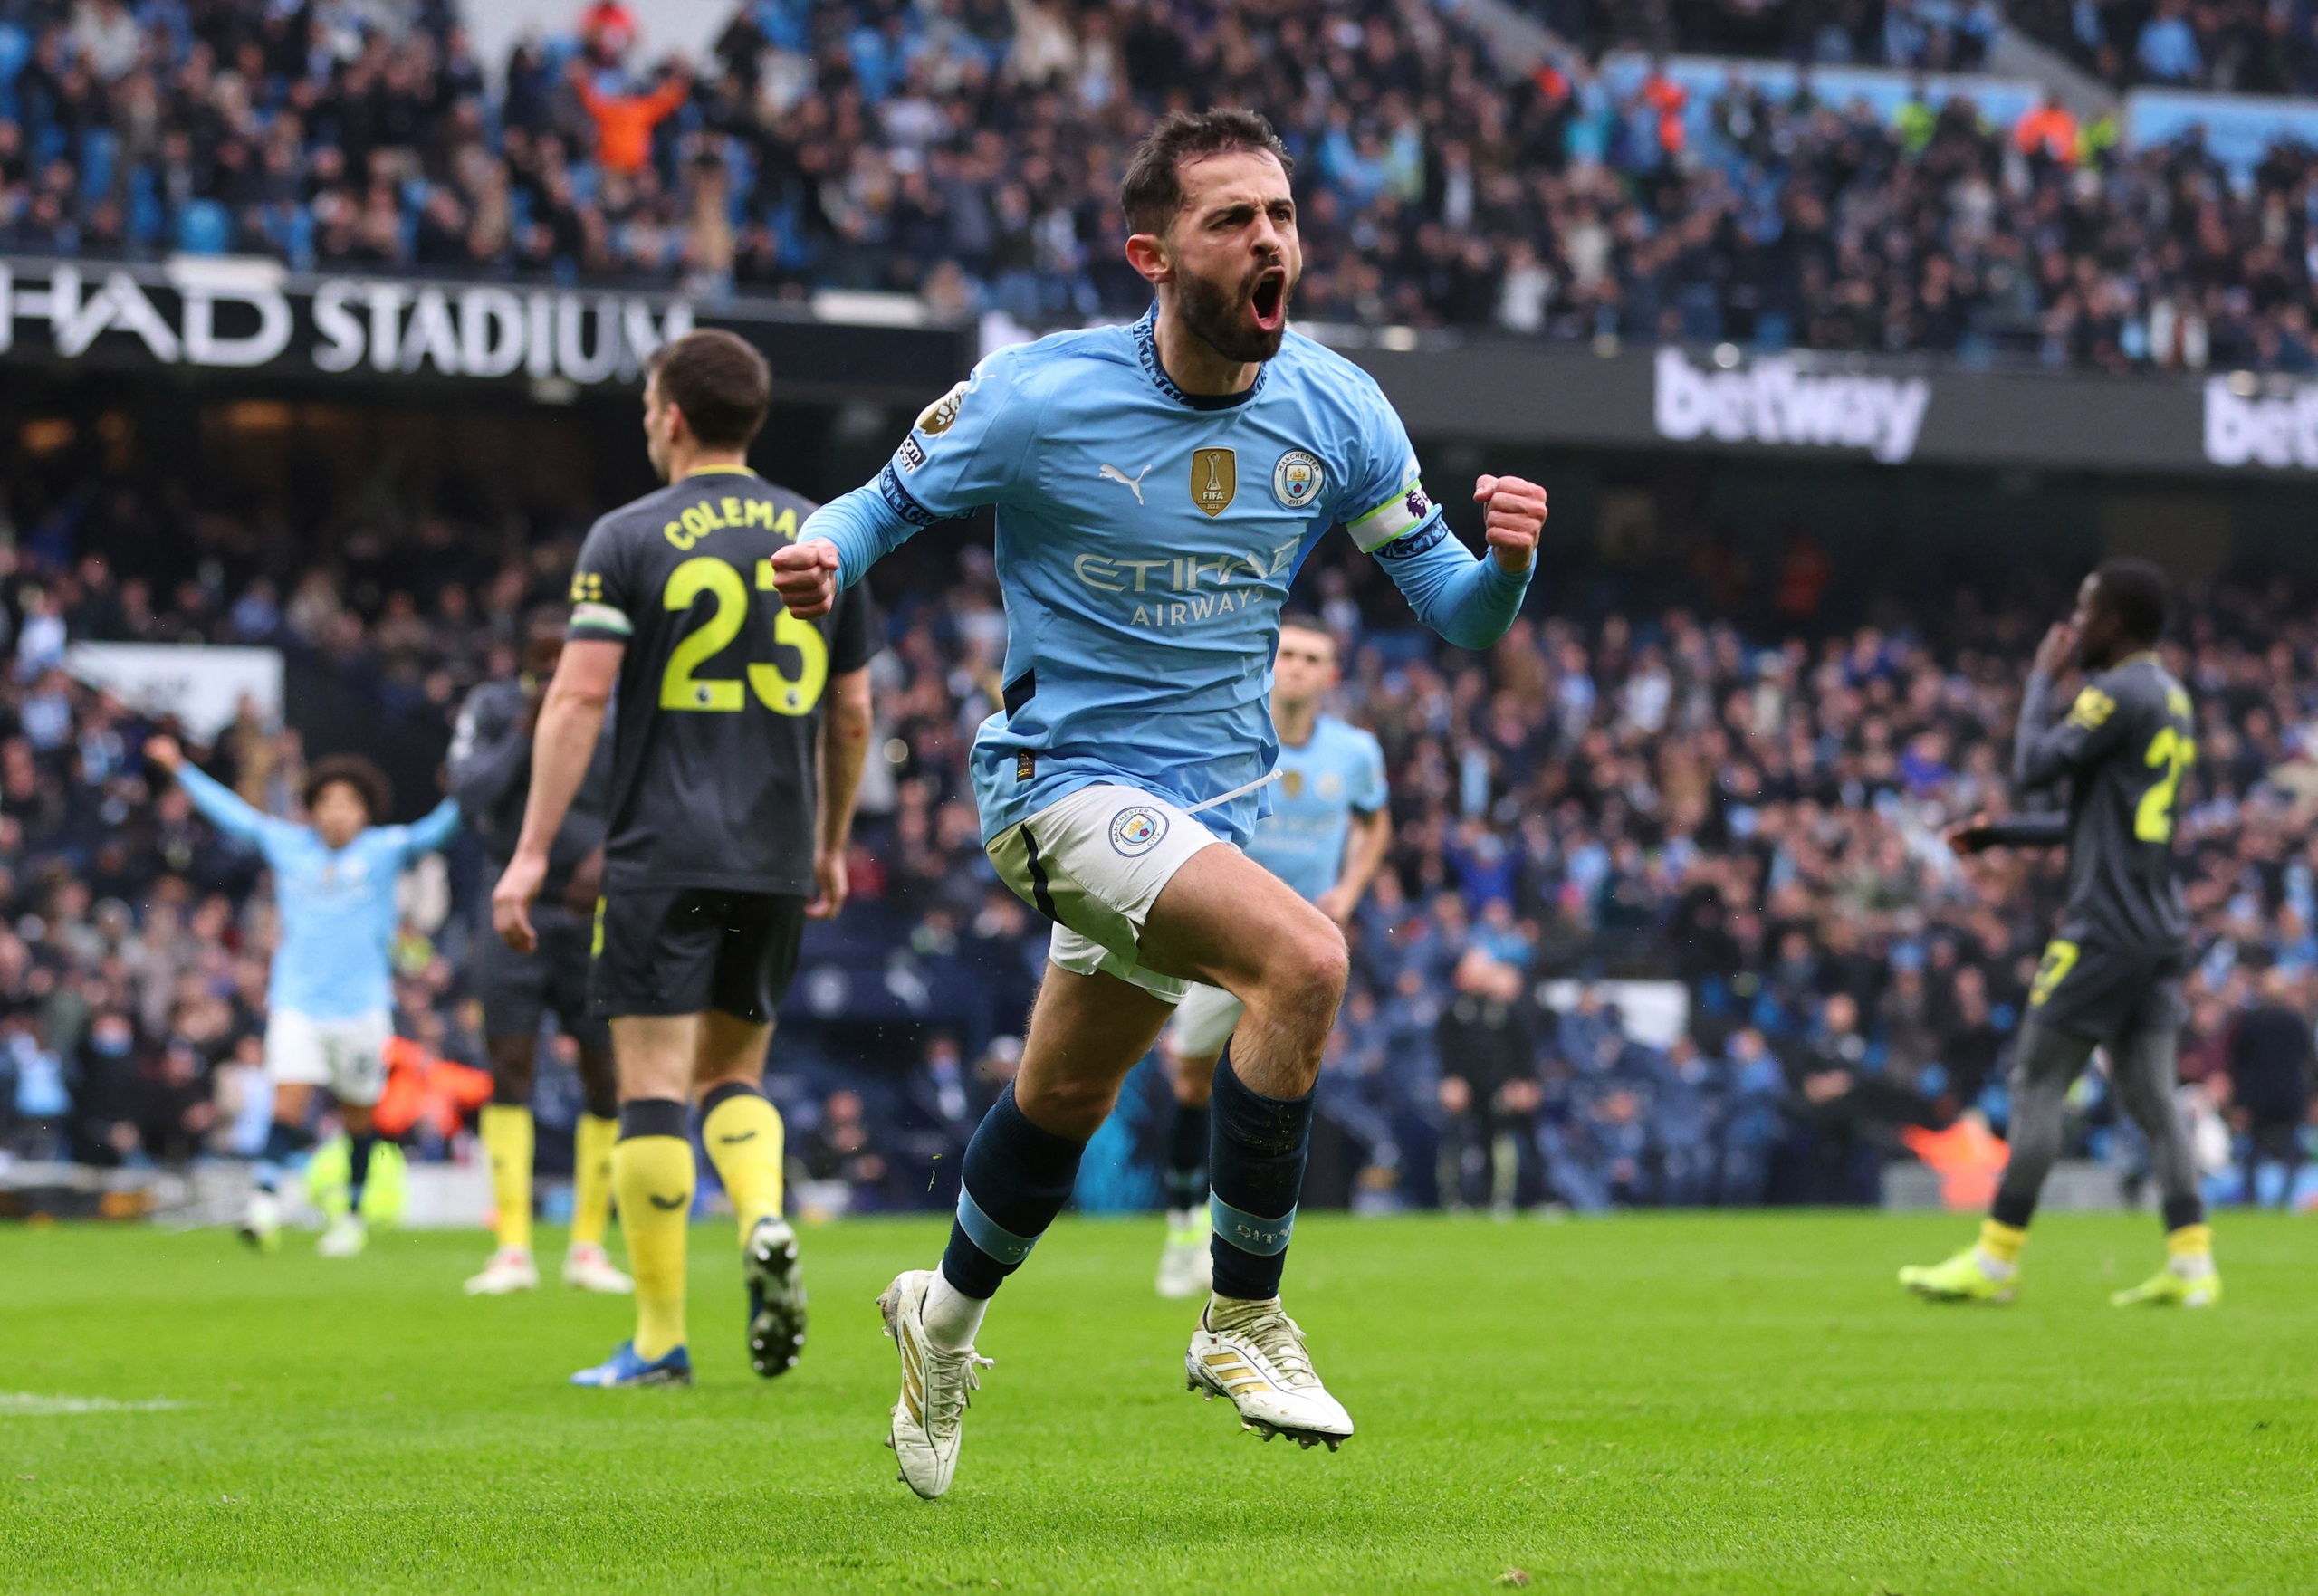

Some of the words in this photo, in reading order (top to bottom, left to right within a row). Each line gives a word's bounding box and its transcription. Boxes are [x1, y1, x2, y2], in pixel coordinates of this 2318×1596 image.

[311, 277, 694, 384] STADIUM
[1654, 347, 1931, 464] betway
[1278, 453, 1320, 473] MANCHESTER
[1202, 491, 1224, 500] FIFA
[1288, 498, 1304, 506] CITY
[664, 497, 800, 551] COLEMA
[1130, 586, 1267, 626] AIRWAYS
[659, 556, 829, 717] 23
[1113, 808, 1149, 843] MANCHESTER
[1146, 832, 1161, 846] CITY
